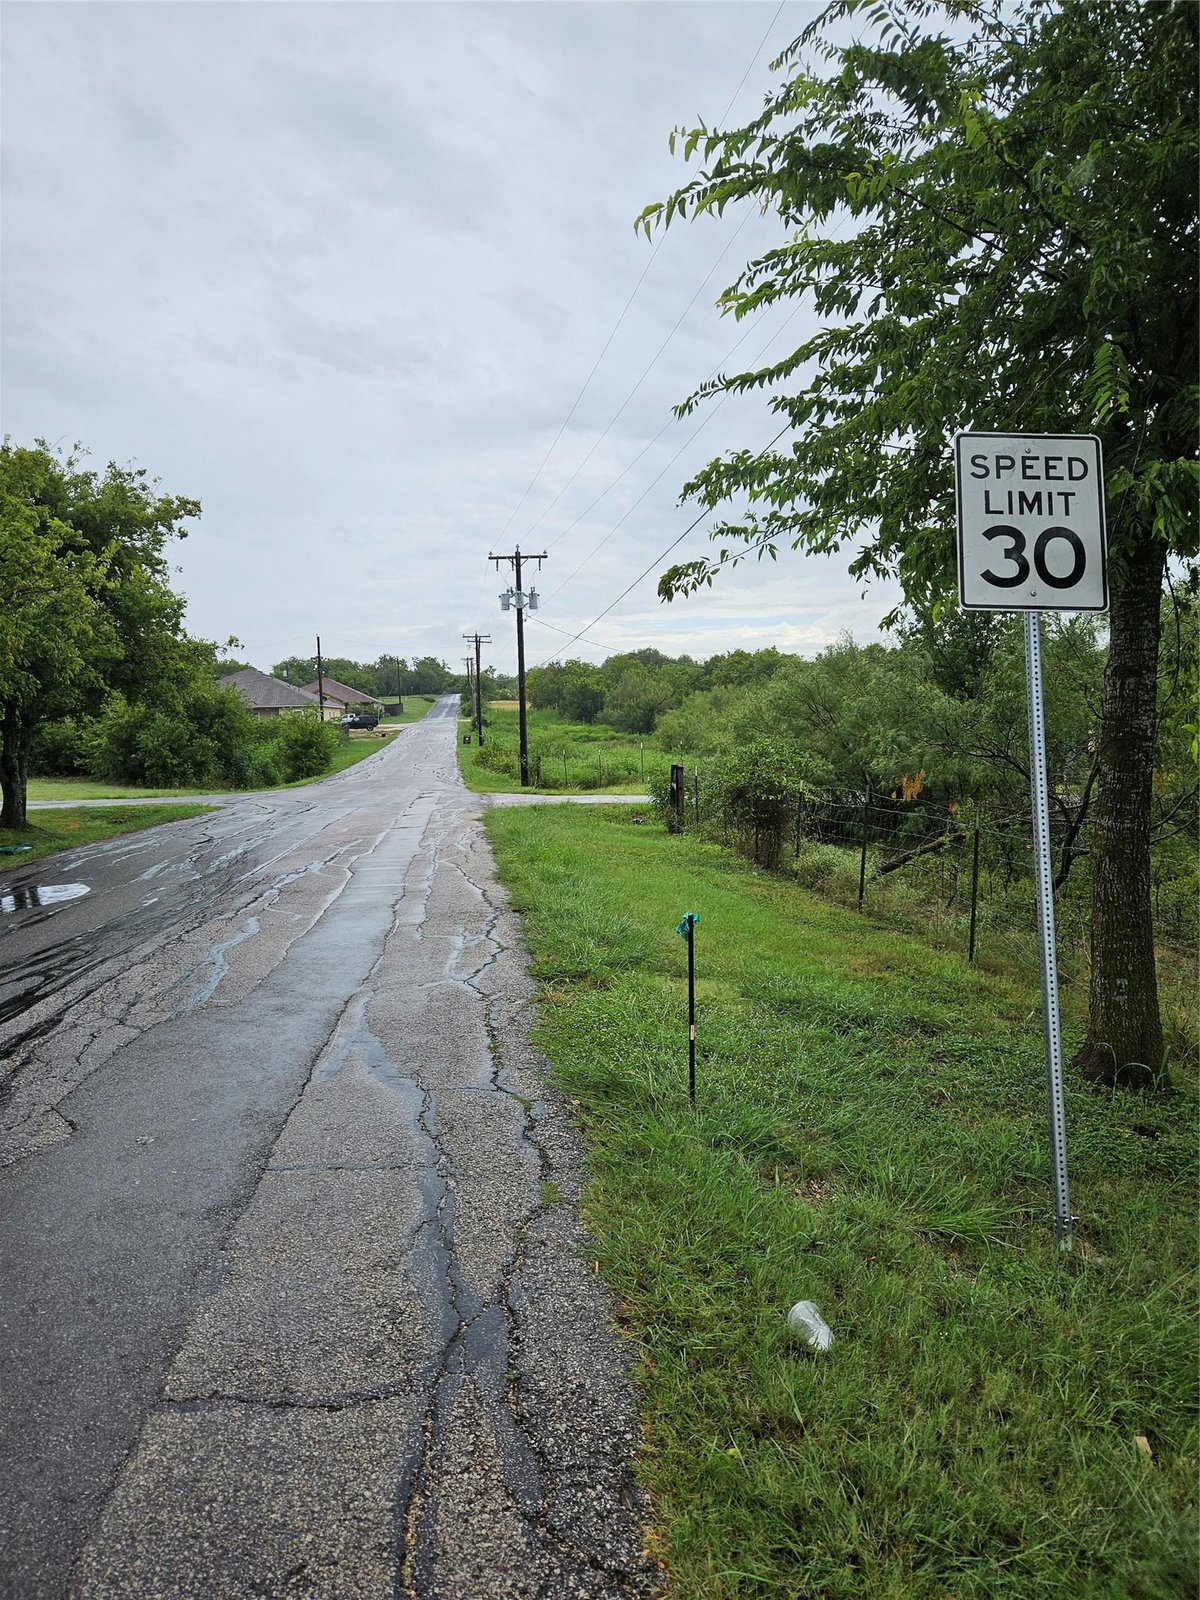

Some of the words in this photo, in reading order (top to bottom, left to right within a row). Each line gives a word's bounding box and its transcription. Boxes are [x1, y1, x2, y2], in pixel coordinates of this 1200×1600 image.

[970, 454, 1089, 481] SPEED
[984, 489, 1076, 516] LIMIT
[979, 524, 1087, 590] 30
